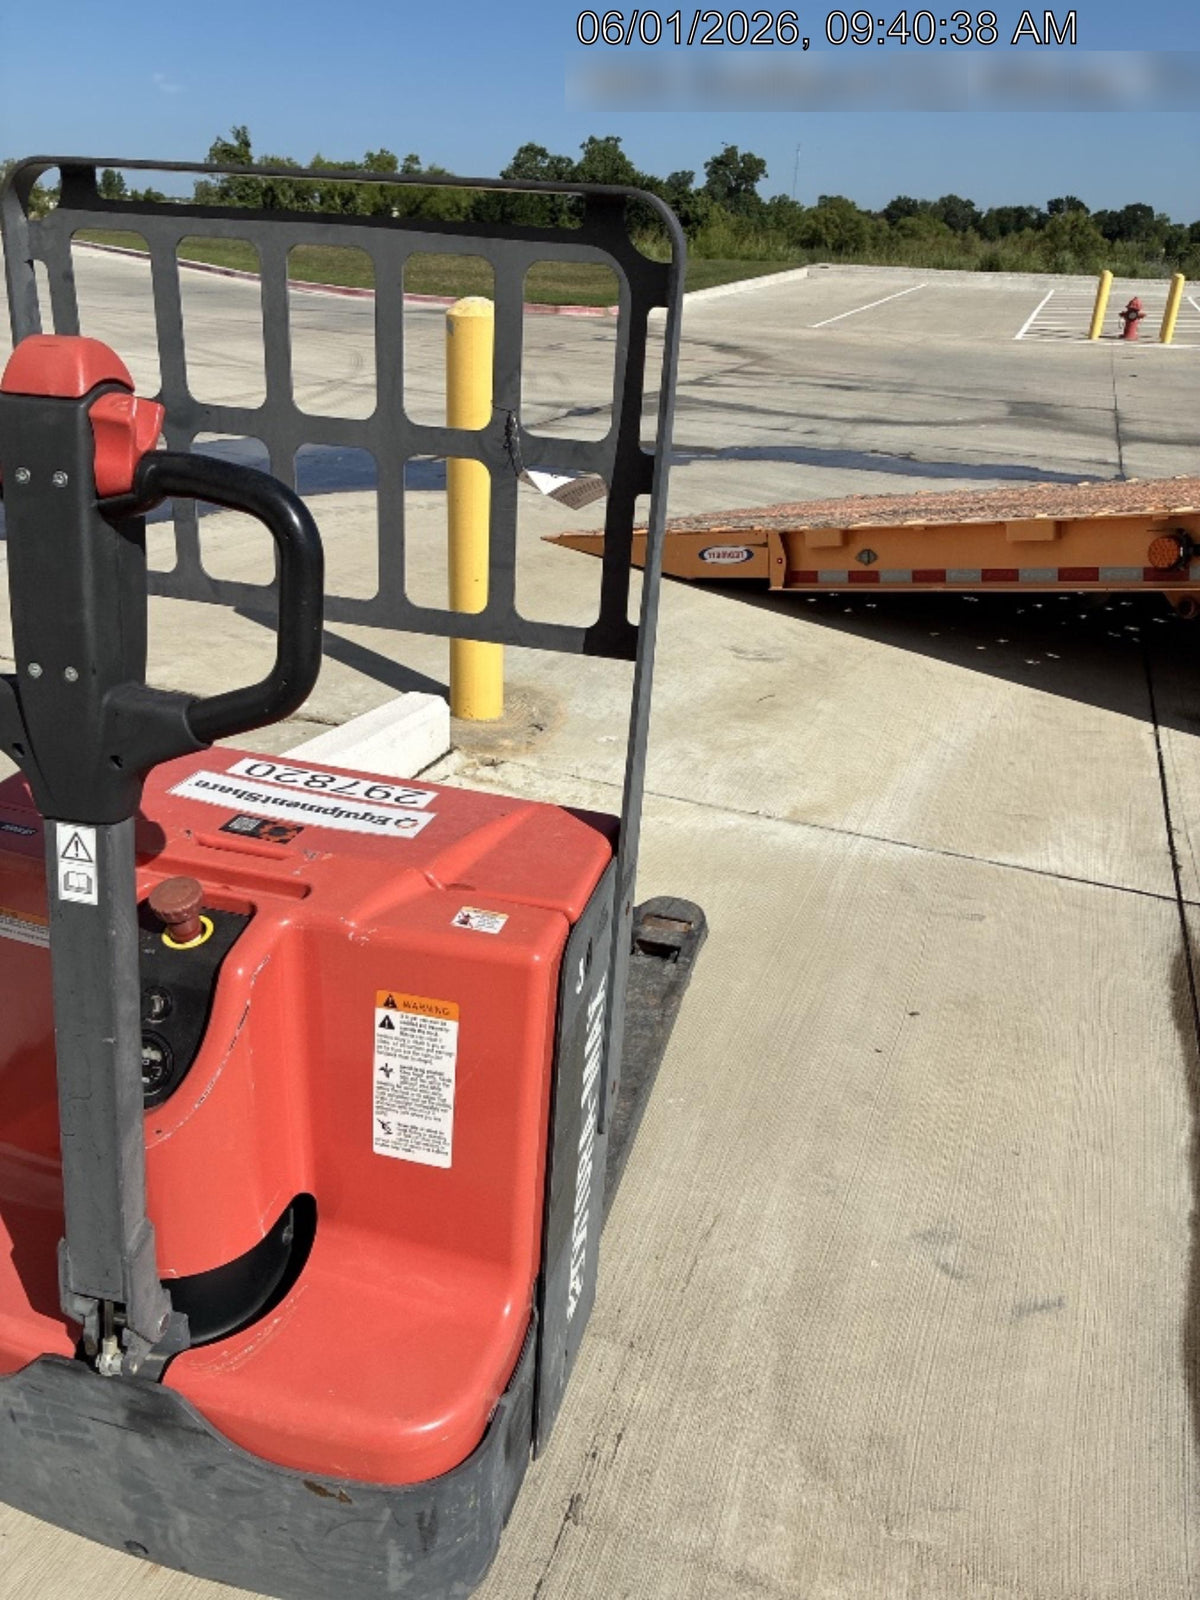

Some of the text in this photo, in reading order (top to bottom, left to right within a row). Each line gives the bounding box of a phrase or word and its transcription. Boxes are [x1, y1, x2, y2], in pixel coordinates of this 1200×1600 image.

[194, 779, 393, 827] EquipmentShare
[245, 763, 427, 804] 297820
[402, 1000, 450, 1016] WARNING
